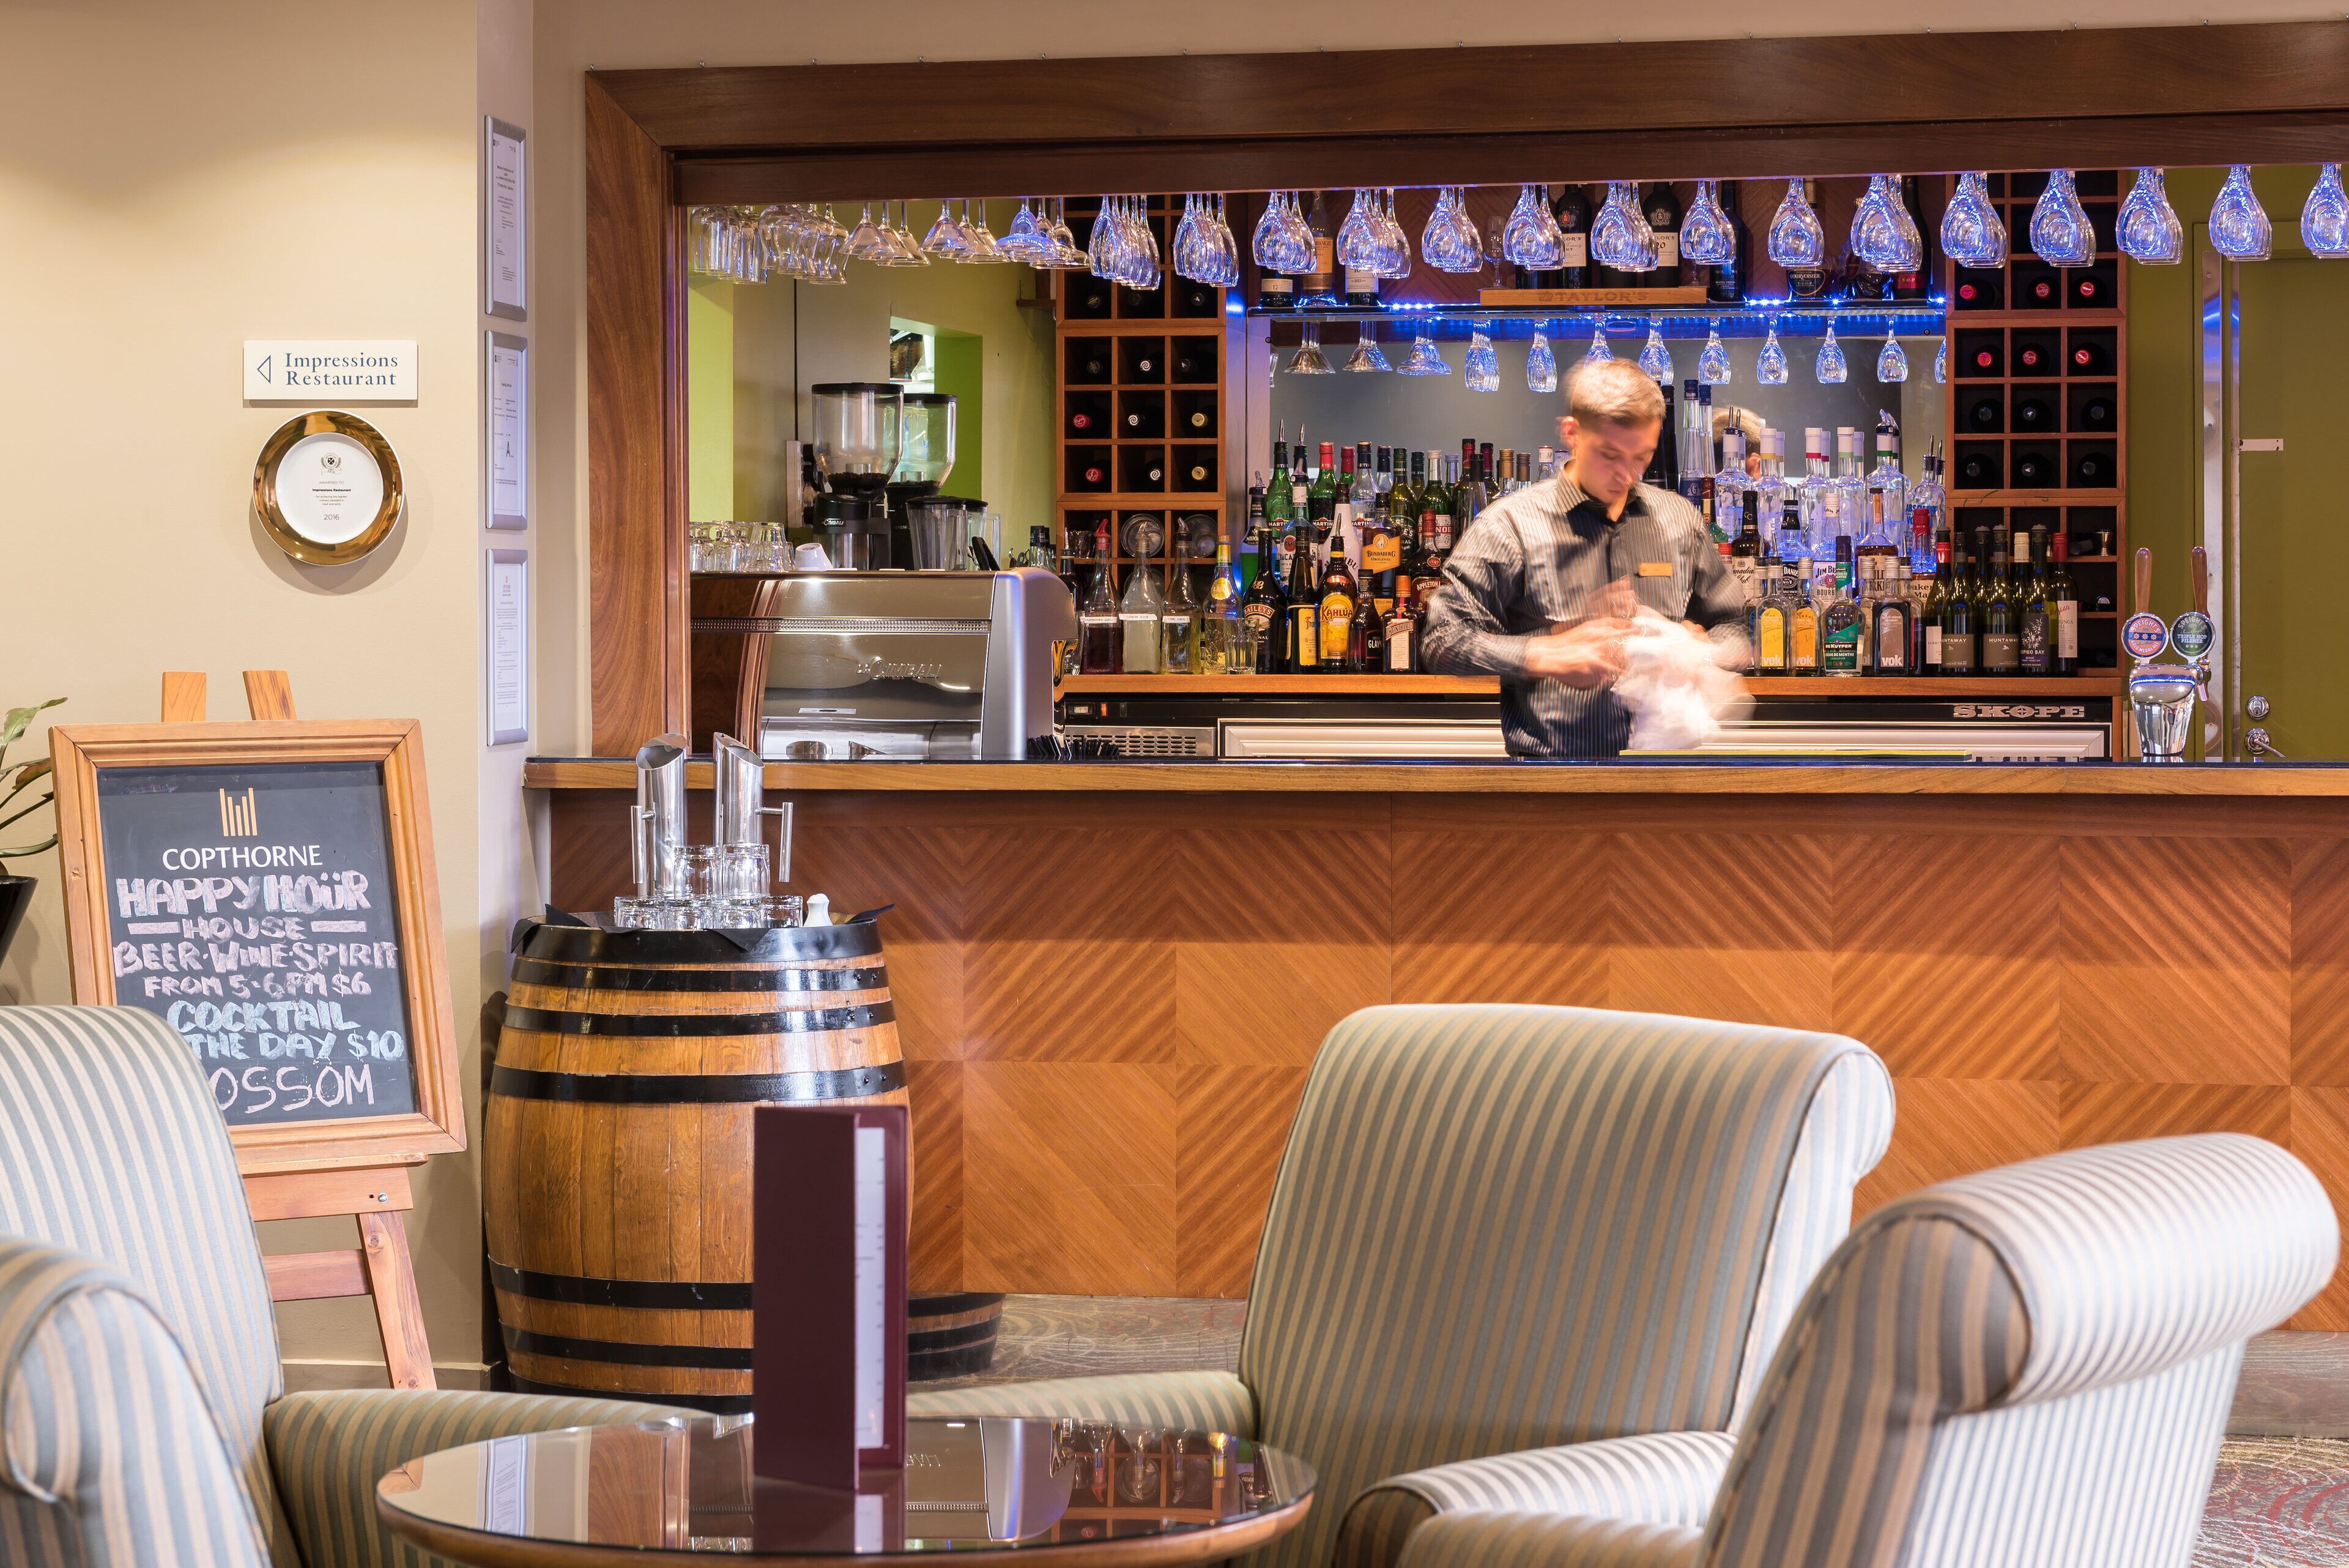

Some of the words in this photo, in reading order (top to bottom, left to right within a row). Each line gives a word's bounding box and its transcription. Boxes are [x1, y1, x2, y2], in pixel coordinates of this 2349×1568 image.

[1556, 292, 1649, 302] TAYLOR'S
[284, 352, 398, 372] Impressions
[285, 371, 396, 385] Restaurant
[1816, 567, 1827, 578] JIM
[1417, 581, 1438, 591] APPLETON
[1244, 604, 1274, 615] BAILEYS
[1321, 606, 1353, 622] KAHLÚA
[1387, 622, 1413, 637] COINTREAU
[2131, 619, 2160, 633] SPEIGHT'S
[2178, 617, 2207, 630] SPEIGHT'S
[1762, 655, 1782, 665] vok
[1882, 655, 1902, 666] vok
[870, 656, 942, 680] CIMBALI
[1953, 705, 2084, 718] SKOPE
[162, 845, 323, 871] COPTHORNE
[116, 875, 261, 918] HAPPY
[182, 915, 307, 943] HOUSE
[113, 941, 203, 978] BEER
[208, 940, 289, 973] WINE
[292, 941, 398, 972] SPIRIT
[143, 976, 224, 998] FROM
[332, 967, 372, 998] $6
[167, 999, 362, 1033] COCKTAIL
[184, 1032, 250, 1060] THE
[259, 1032, 337, 1060] DAY
[347, 1030, 405, 1061] $10
[209, 1063, 374, 1114] OSSOM
